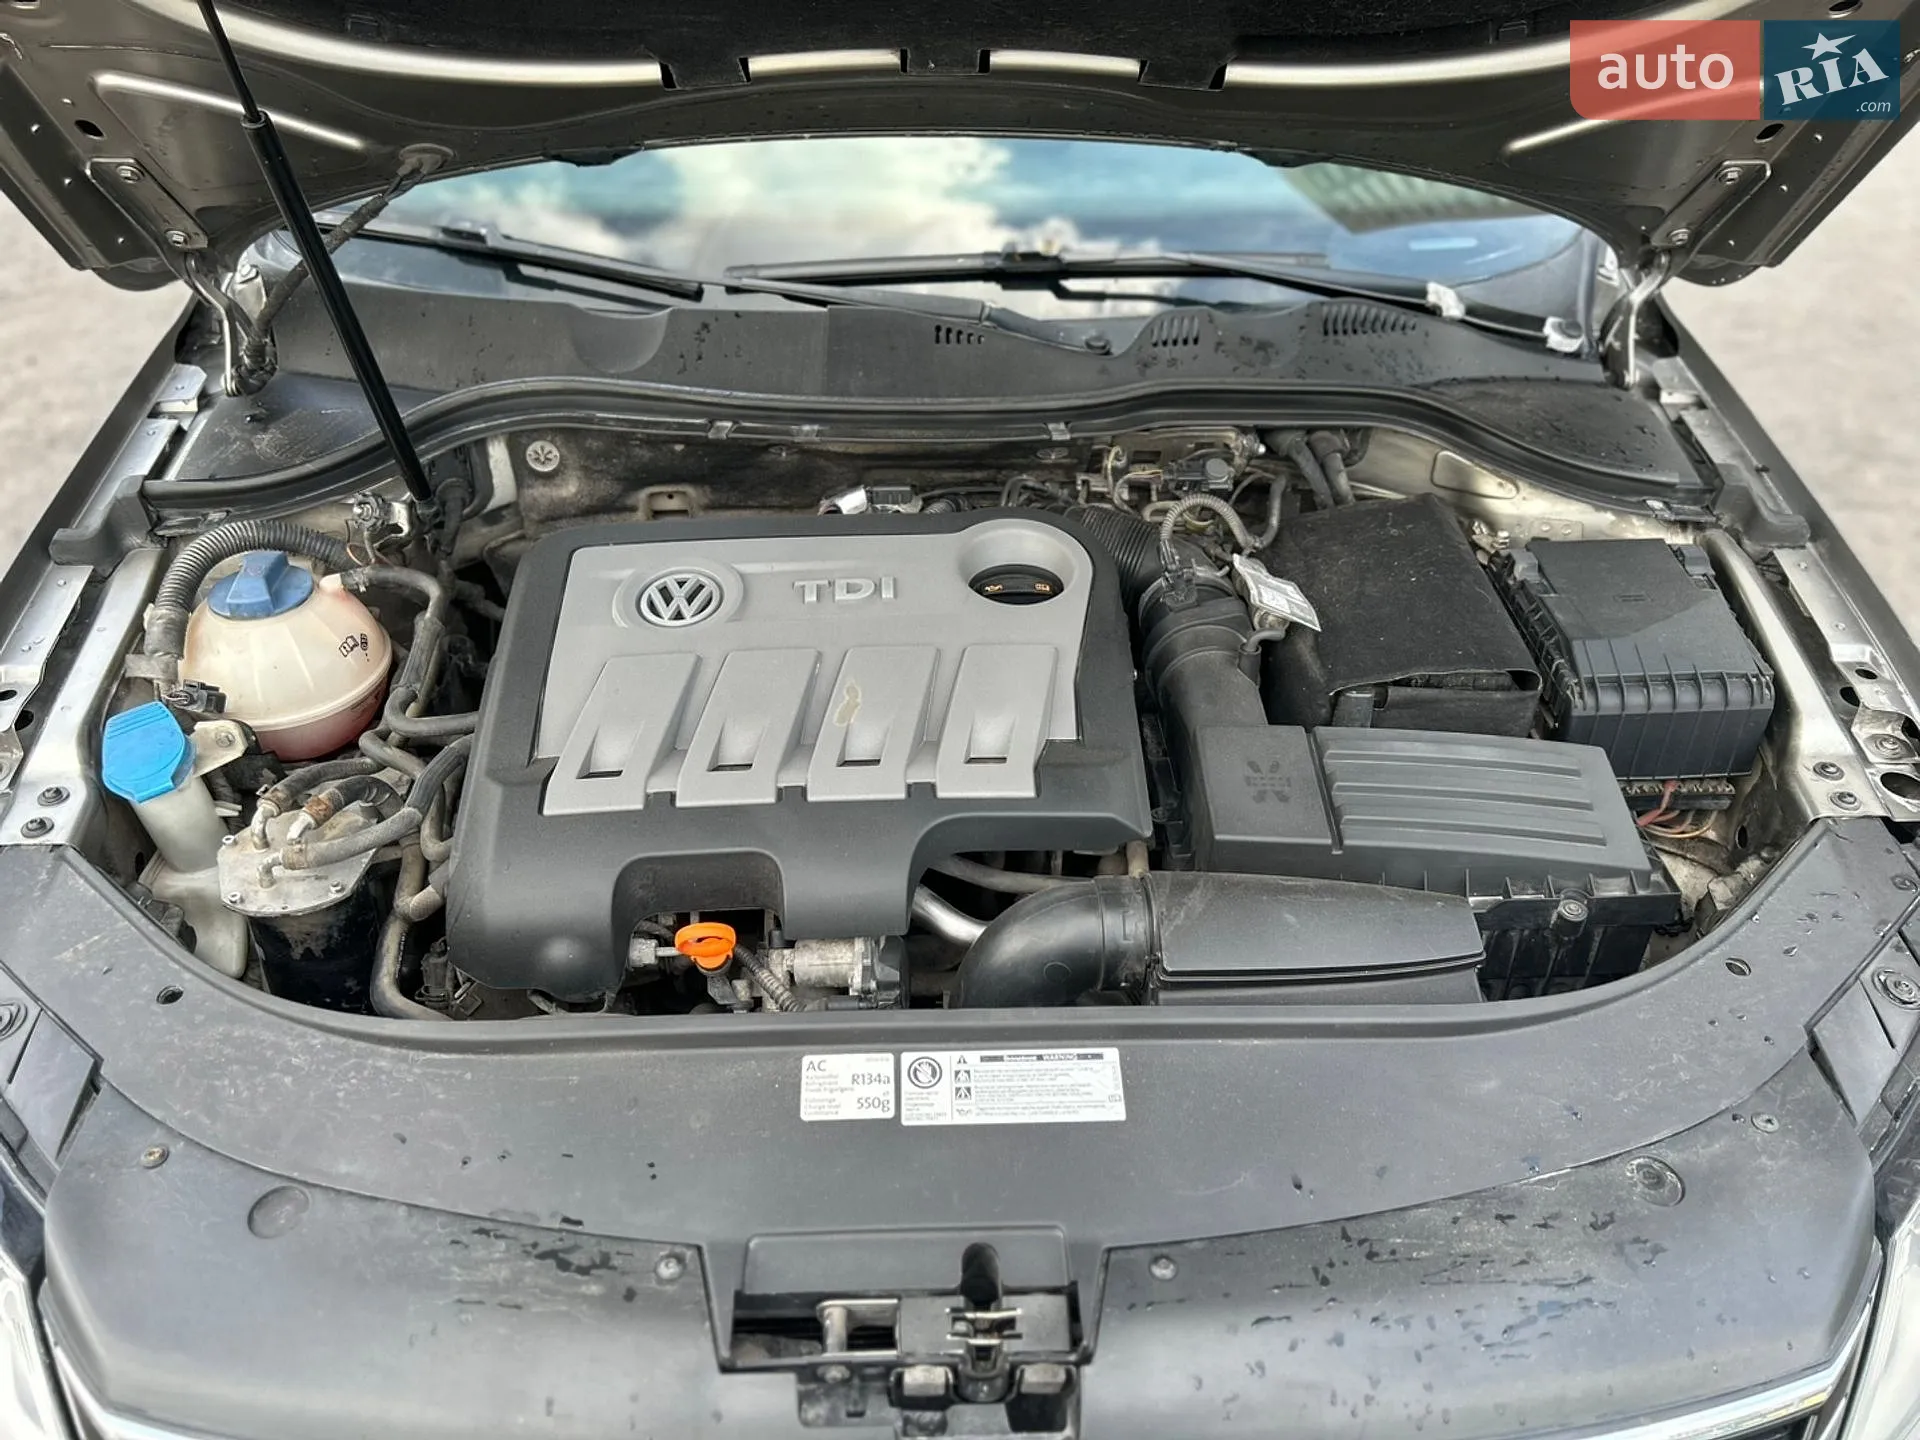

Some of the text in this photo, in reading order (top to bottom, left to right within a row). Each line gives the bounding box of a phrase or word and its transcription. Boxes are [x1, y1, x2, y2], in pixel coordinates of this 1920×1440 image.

[792, 576, 896, 604] TDI
[641, 574, 720, 626] VW
[806, 1059, 827, 1072] AC
[851, 1072, 891, 1085] R134a
[857, 1096, 890, 1114] 550g
